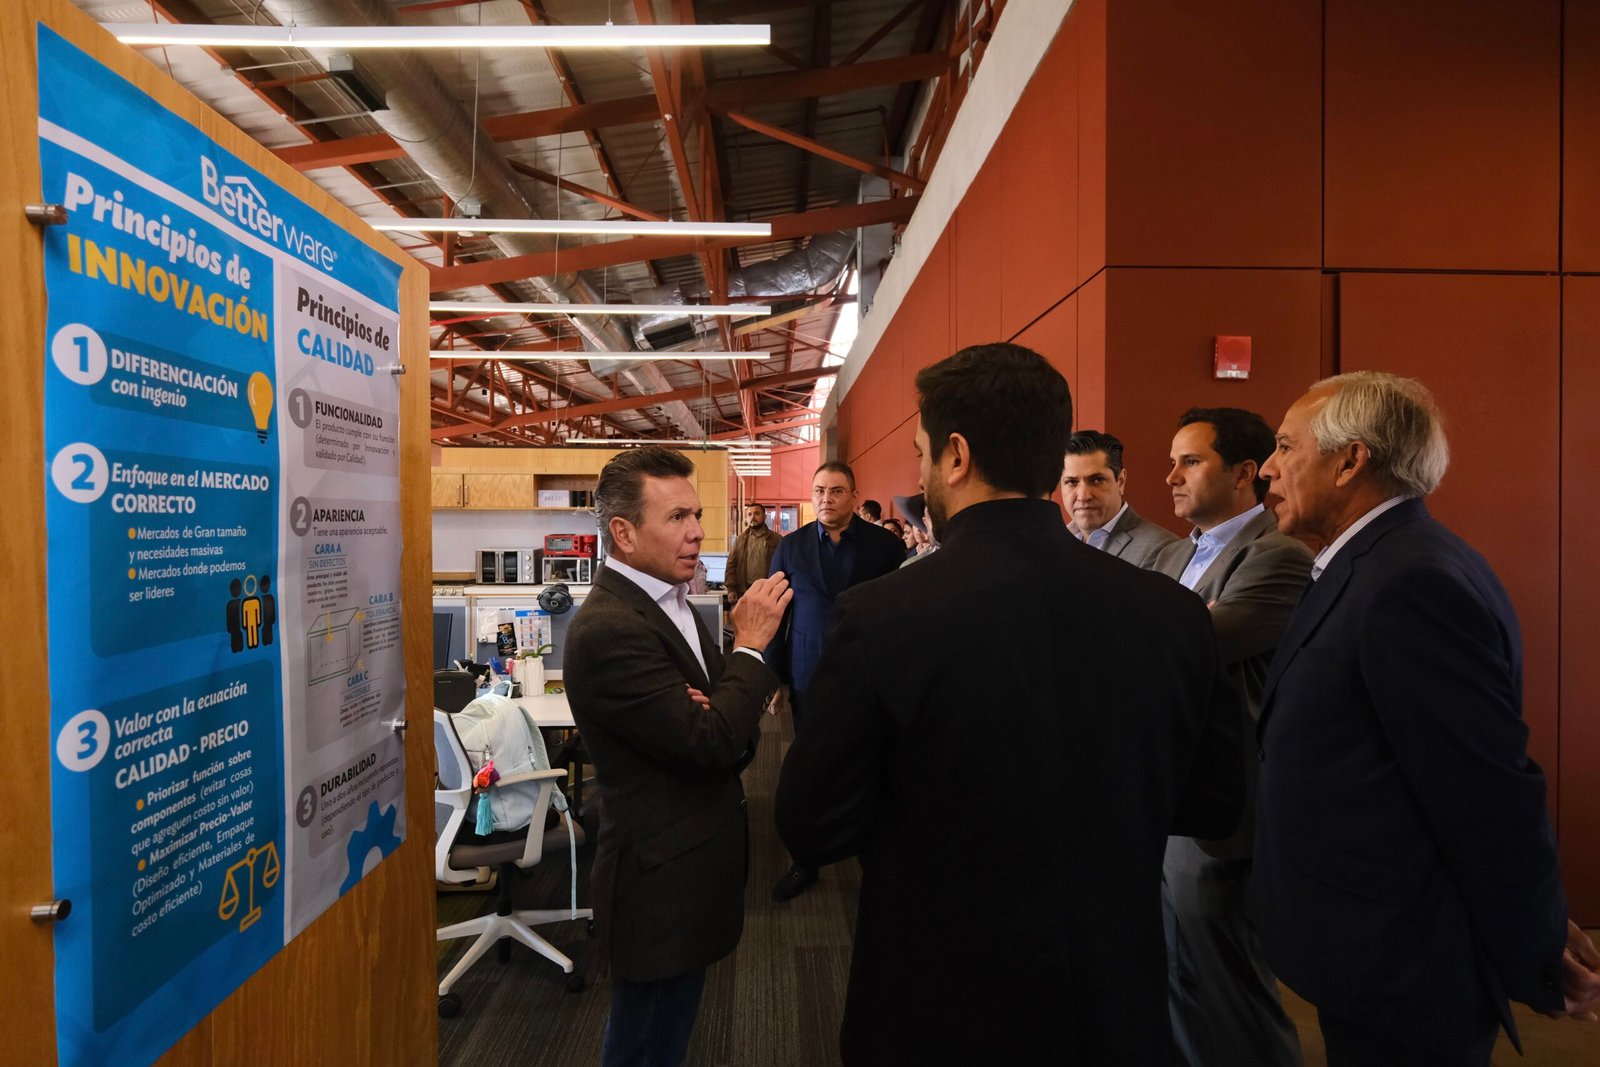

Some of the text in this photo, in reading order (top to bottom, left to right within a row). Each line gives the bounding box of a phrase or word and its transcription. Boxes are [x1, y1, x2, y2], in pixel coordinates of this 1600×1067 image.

[64, 171, 251, 290] Principios de
[67, 234, 269, 343] INNOVACIÓN
[297, 287, 390, 351] Principios de
[73, 336, 90, 373] 1
[297, 328, 375, 378] CALIDAD
[112, 349, 239, 399] DIFERENCIACIÓN
[111, 378, 188, 408] con ingenio
[295, 395, 305, 421] 1
[315, 401, 383, 429] FUNCIONALIDAD
[315, 419, 321, 429] El
[322, 422, 345, 435] producto
[345, 427, 362, 439] cumple
[363, 431, 372, 439] con
[71, 453, 95, 490] 2
[112, 463, 270, 492] Enfoque en el MERCADO
[111, 493, 197, 514] CORRECTO
[296, 503, 307, 529] 2
[313, 509, 365, 522] APARIENCIA
[137, 525, 247, 541] Mercados de Gran tamaño
[313, 527, 328, 537] Tiene
[314, 542, 342, 555] CARA A
[129, 545, 223, 564] y necesidades masivas
[138, 561, 246, 581] Mercados donde podemos
[319, 557, 346, 568] DEFECTOS
[129, 590, 143, 603] ser
[368, 592, 394, 605] CARA B
[364, 670, 369, 680] C
[115, 680, 248, 739] Valor con la ecuación
[76, 720, 99, 761] 3
[115, 725, 174, 761] correcta
[115, 743, 191, 790] CALIDAD
[200, 719, 250, 754] PRECIO
[147, 749, 252, 806] Priorizar función sobre
[320, 753, 377, 798] DURABILIDAD
[131, 766, 253, 835] componentes (evitar cosas
[131, 780, 254, 856] que agreguen costo sin valor)
[303, 792, 312, 820] 3
[149, 799, 254, 866] Maximizar Precio-Valor
[132, 816, 255, 899] (Diseño eficiente, Empaque
[132, 832, 256, 918] Optimizado y Materiales de
[131, 881, 203, 938] costo eficiente)
